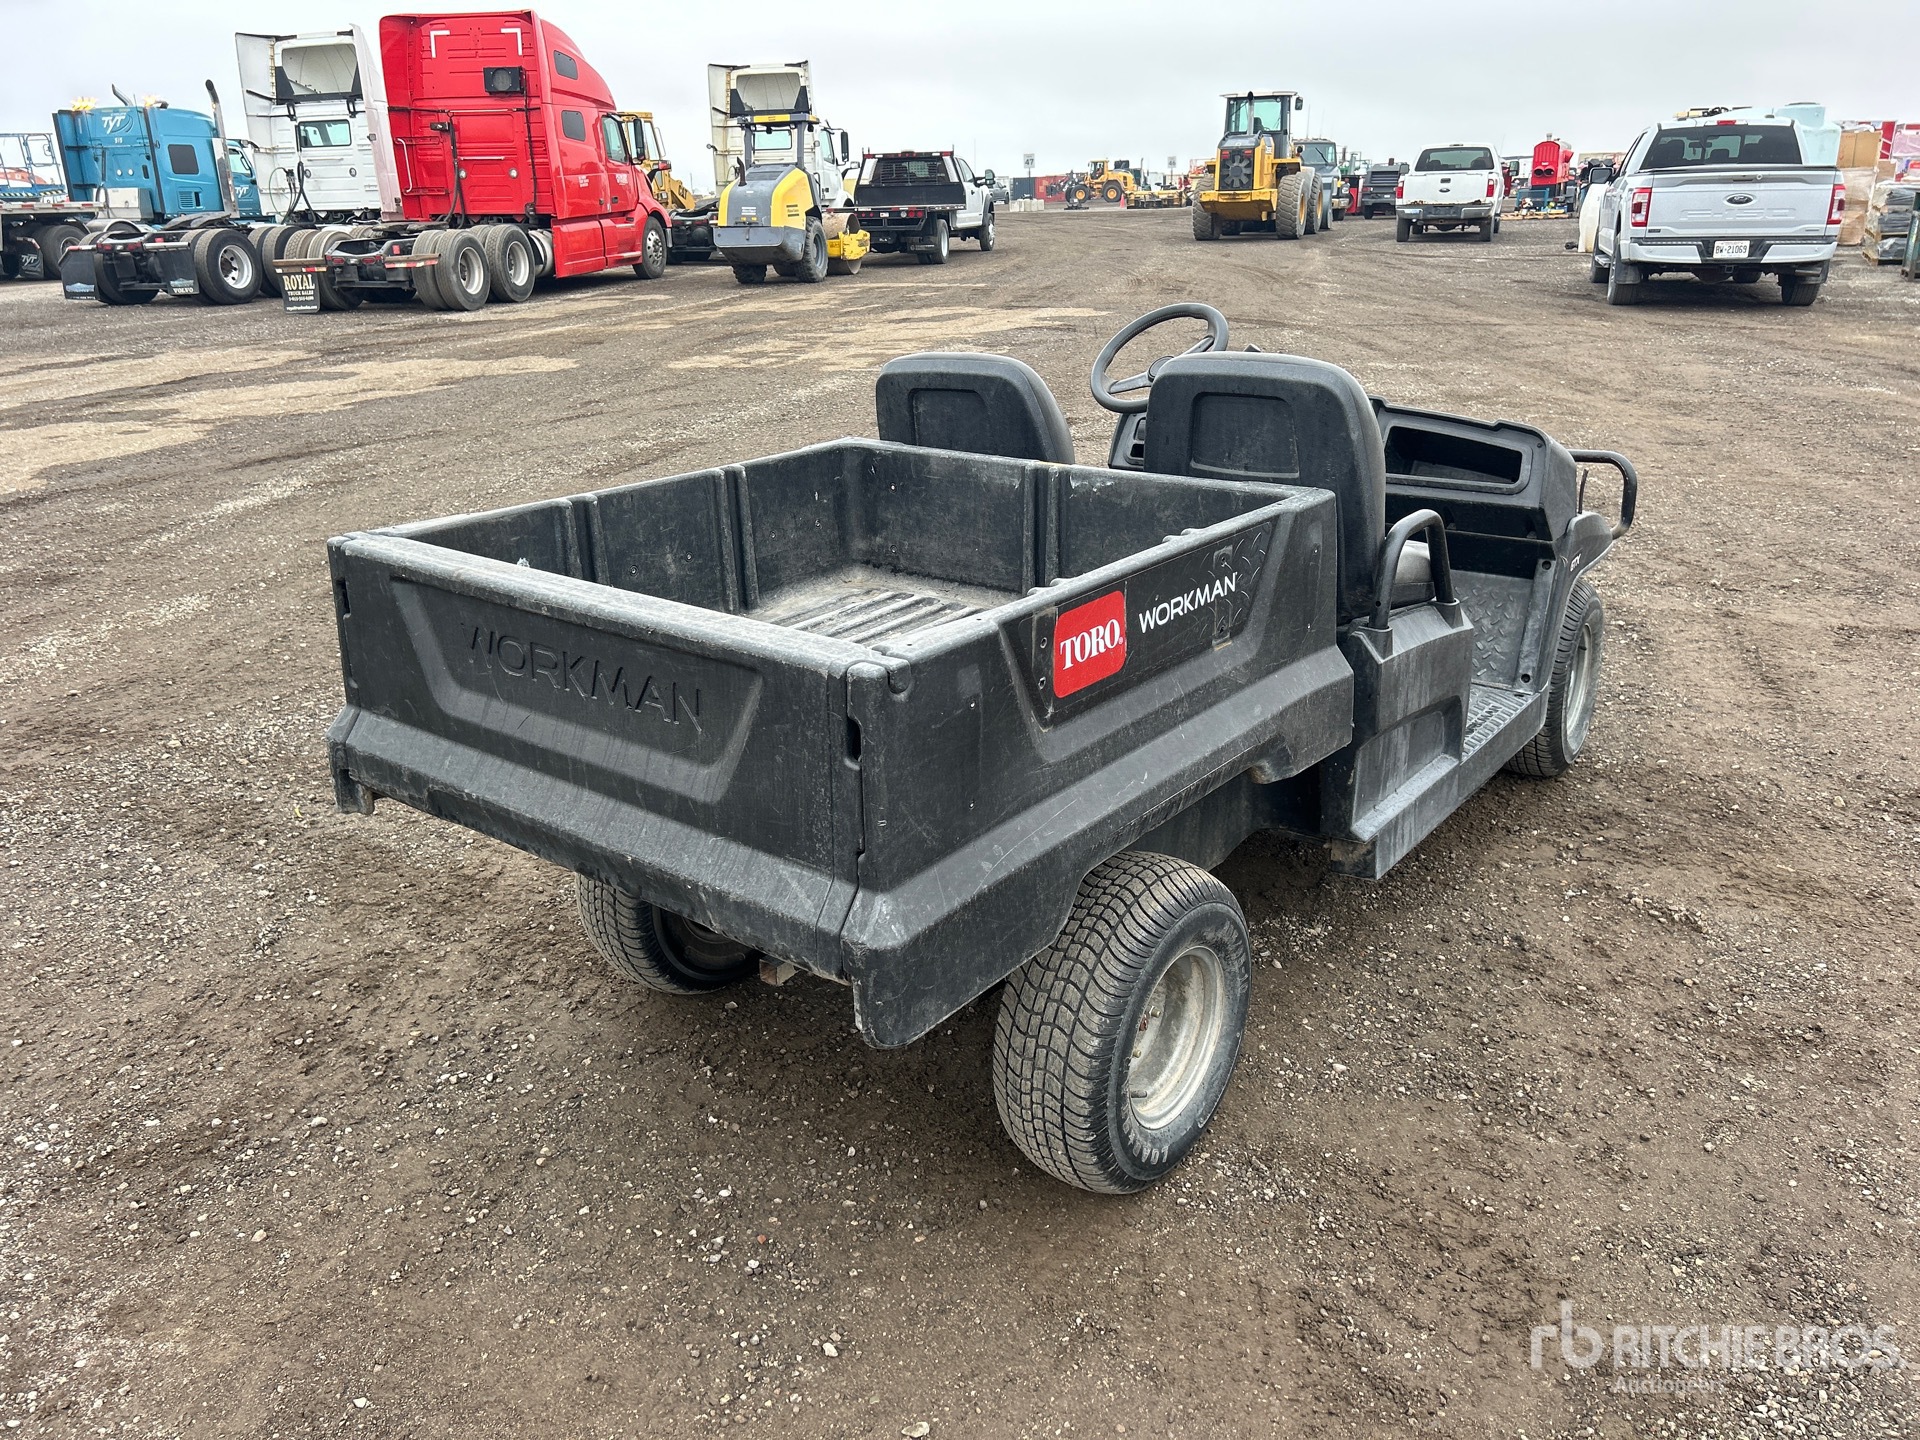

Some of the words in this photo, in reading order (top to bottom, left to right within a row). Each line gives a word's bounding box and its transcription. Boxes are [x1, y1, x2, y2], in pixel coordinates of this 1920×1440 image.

[102, 115, 126, 135] TYT
[234, 186, 250, 198] TYT
[21, 254, 38, 267] TYT
[282, 274, 316, 290] ROYAL
[1138, 572, 1236, 634] WORKMAN
[461, 622, 702, 734] WORKMAN
